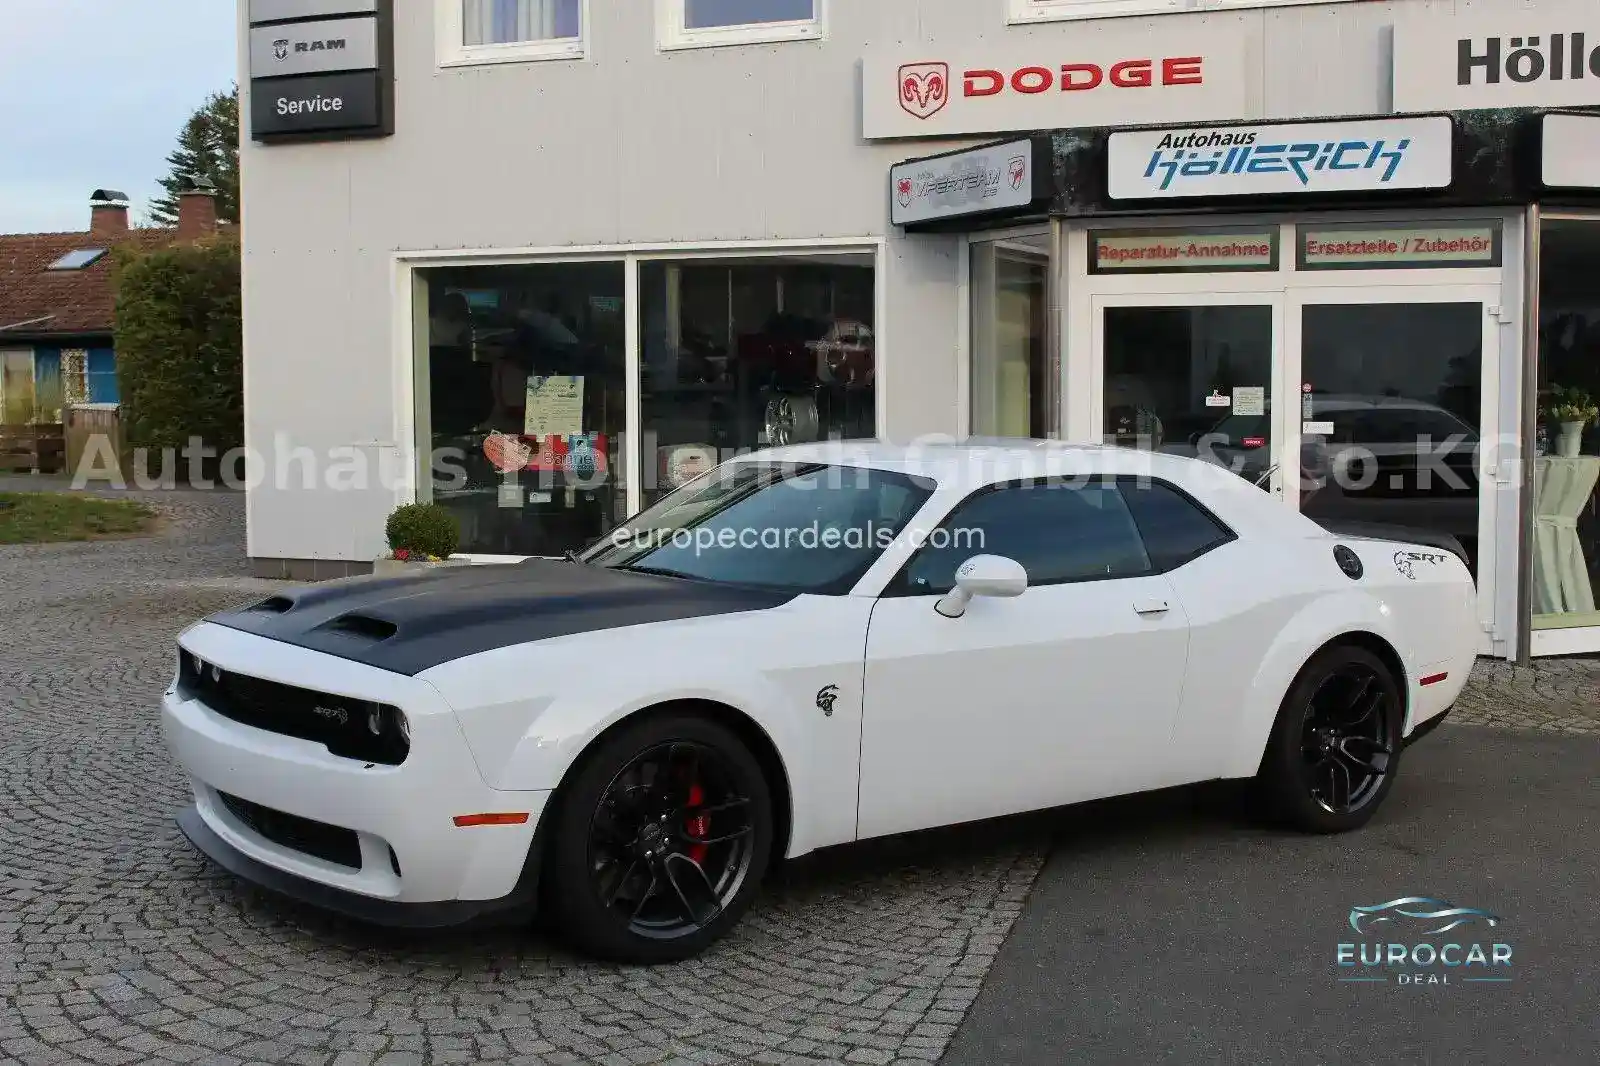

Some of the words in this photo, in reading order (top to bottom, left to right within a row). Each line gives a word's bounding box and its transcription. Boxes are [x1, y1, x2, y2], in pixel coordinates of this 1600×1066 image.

[295, 39, 346, 52] RAM
[963, 56, 1204, 98] DODGE
[276, 95, 343, 115] Service
[1156, 131, 1257, 150] Autohaus
[1099, 243, 1270, 262] Reparatur-Annahme
[1307, 240, 1398, 255] Ersatzteile
[1414, 237, 1491, 253] Zubehör
[1407, 552, 1447, 565] SRT
